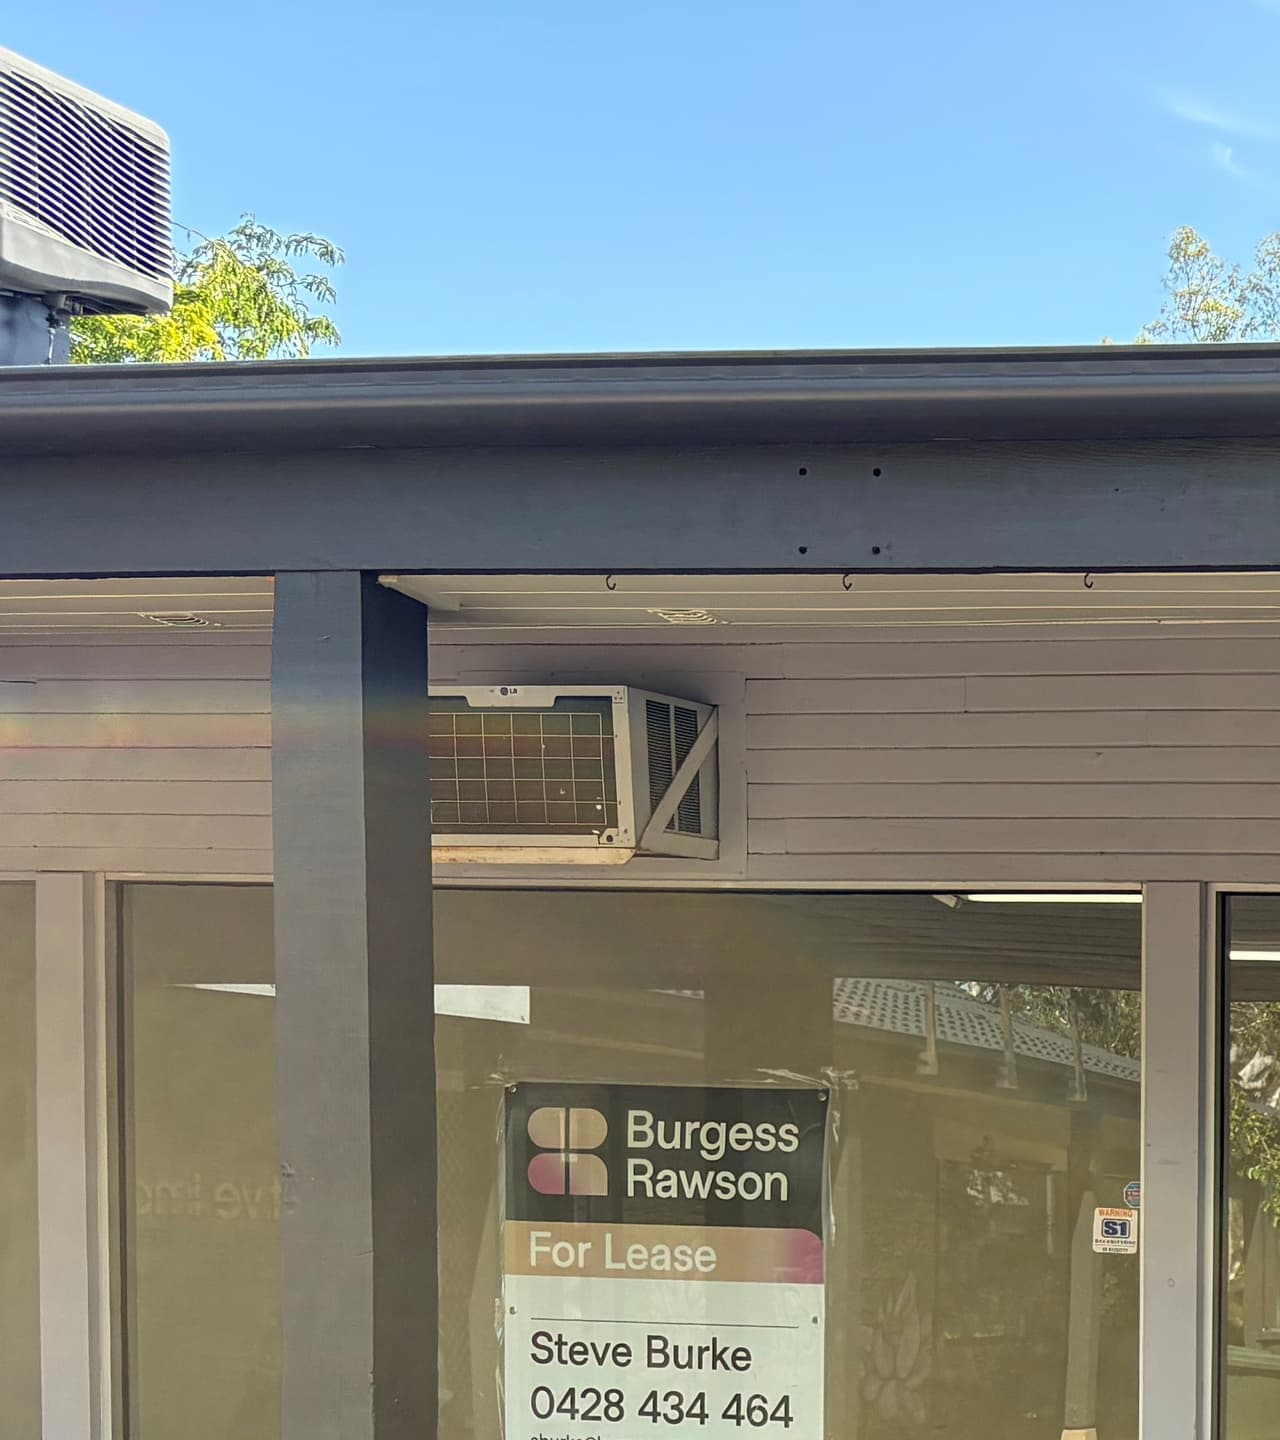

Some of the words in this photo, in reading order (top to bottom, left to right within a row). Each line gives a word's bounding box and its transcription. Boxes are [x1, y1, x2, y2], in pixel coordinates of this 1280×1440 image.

[626, 1109, 800, 1162] Burgess
[626, 1157, 789, 1202] Rawson
[1104, 1221, 1128, 1237] S1
[529, 1230, 593, 1269] For
[604, 1232, 718, 1273] Lease
[530, 1330, 633, 1367] Steve
[645, 1334, 753, 1372] Burke
[530, 1385, 626, 1423] 0428
[637, 1390, 709, 1426] 434
[721, 1392, 794, 1429] 464
